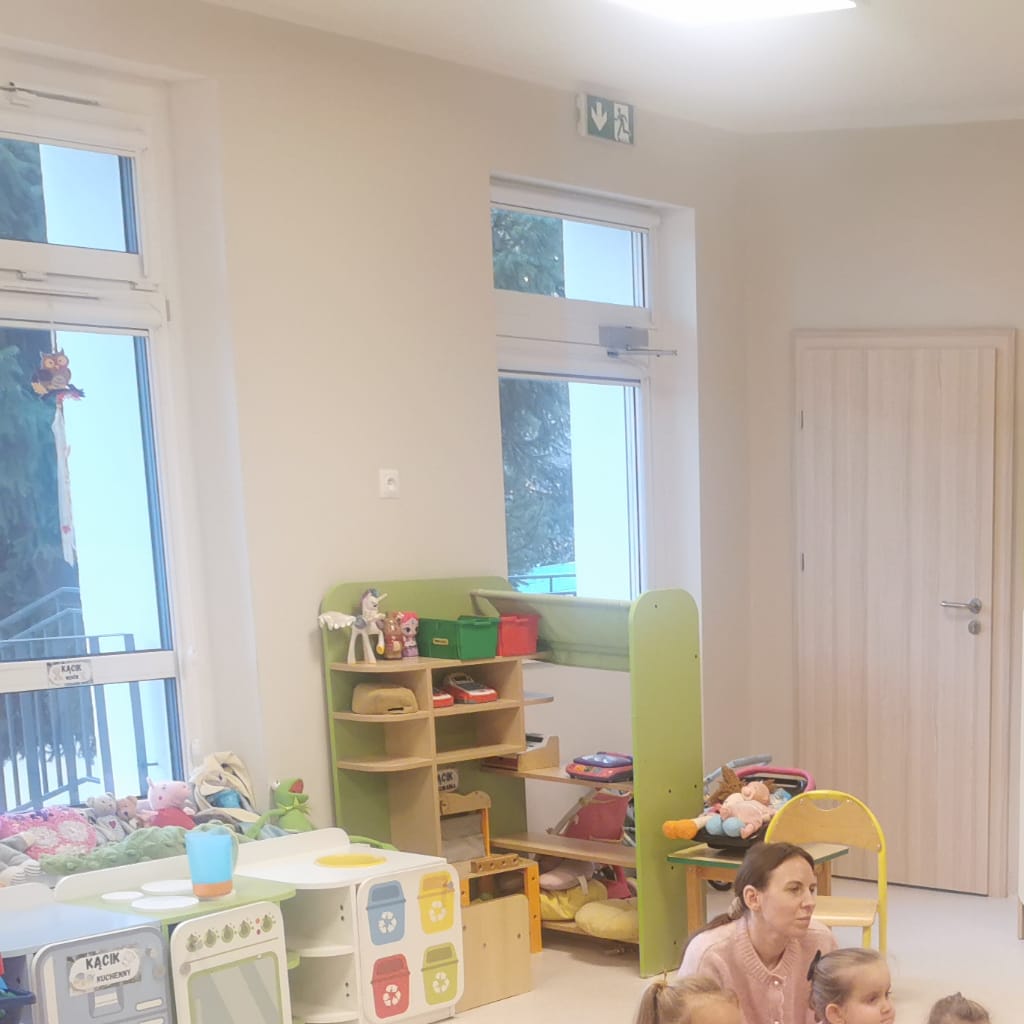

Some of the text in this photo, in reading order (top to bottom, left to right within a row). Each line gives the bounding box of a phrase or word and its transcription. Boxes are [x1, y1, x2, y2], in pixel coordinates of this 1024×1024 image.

[61, 664, 82, 674] KĄCIK
[86, 952, 120, 970] KĄCIK
[96, 969, 131, 982] KUCHENNY
